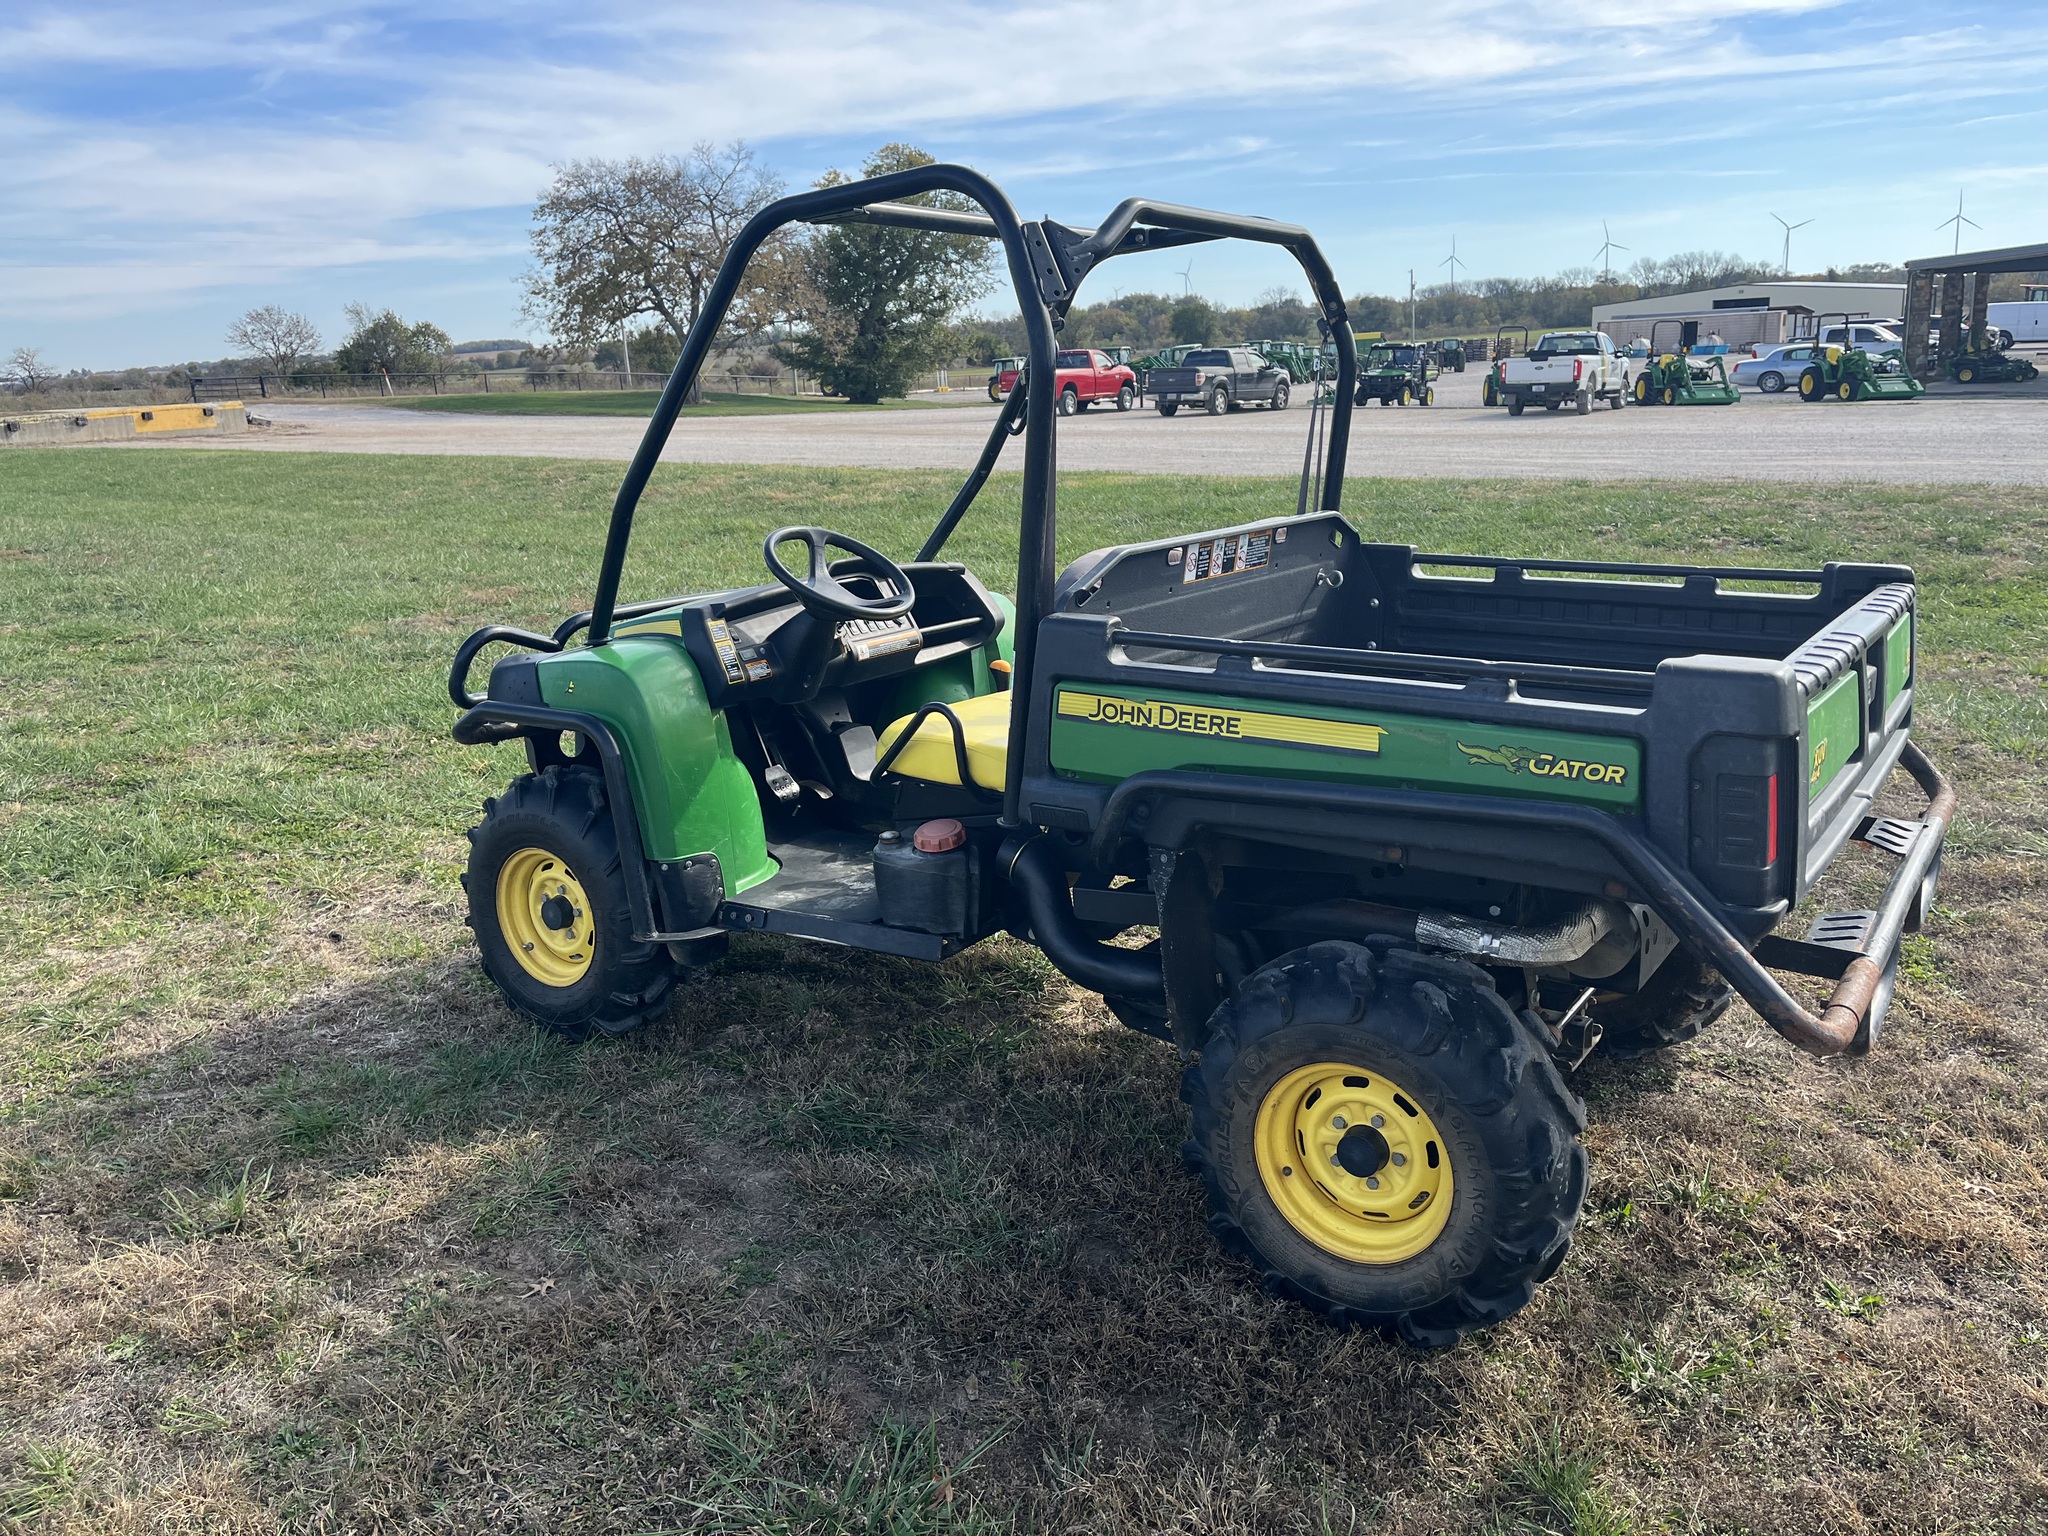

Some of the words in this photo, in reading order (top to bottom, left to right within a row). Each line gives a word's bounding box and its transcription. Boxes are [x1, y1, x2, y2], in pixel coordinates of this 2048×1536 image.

[1088, 698, 1153, 727] JOHN
[1159, 705, 1242, 737] DEERE
[1528, 754, 1627, 785] GATOR
